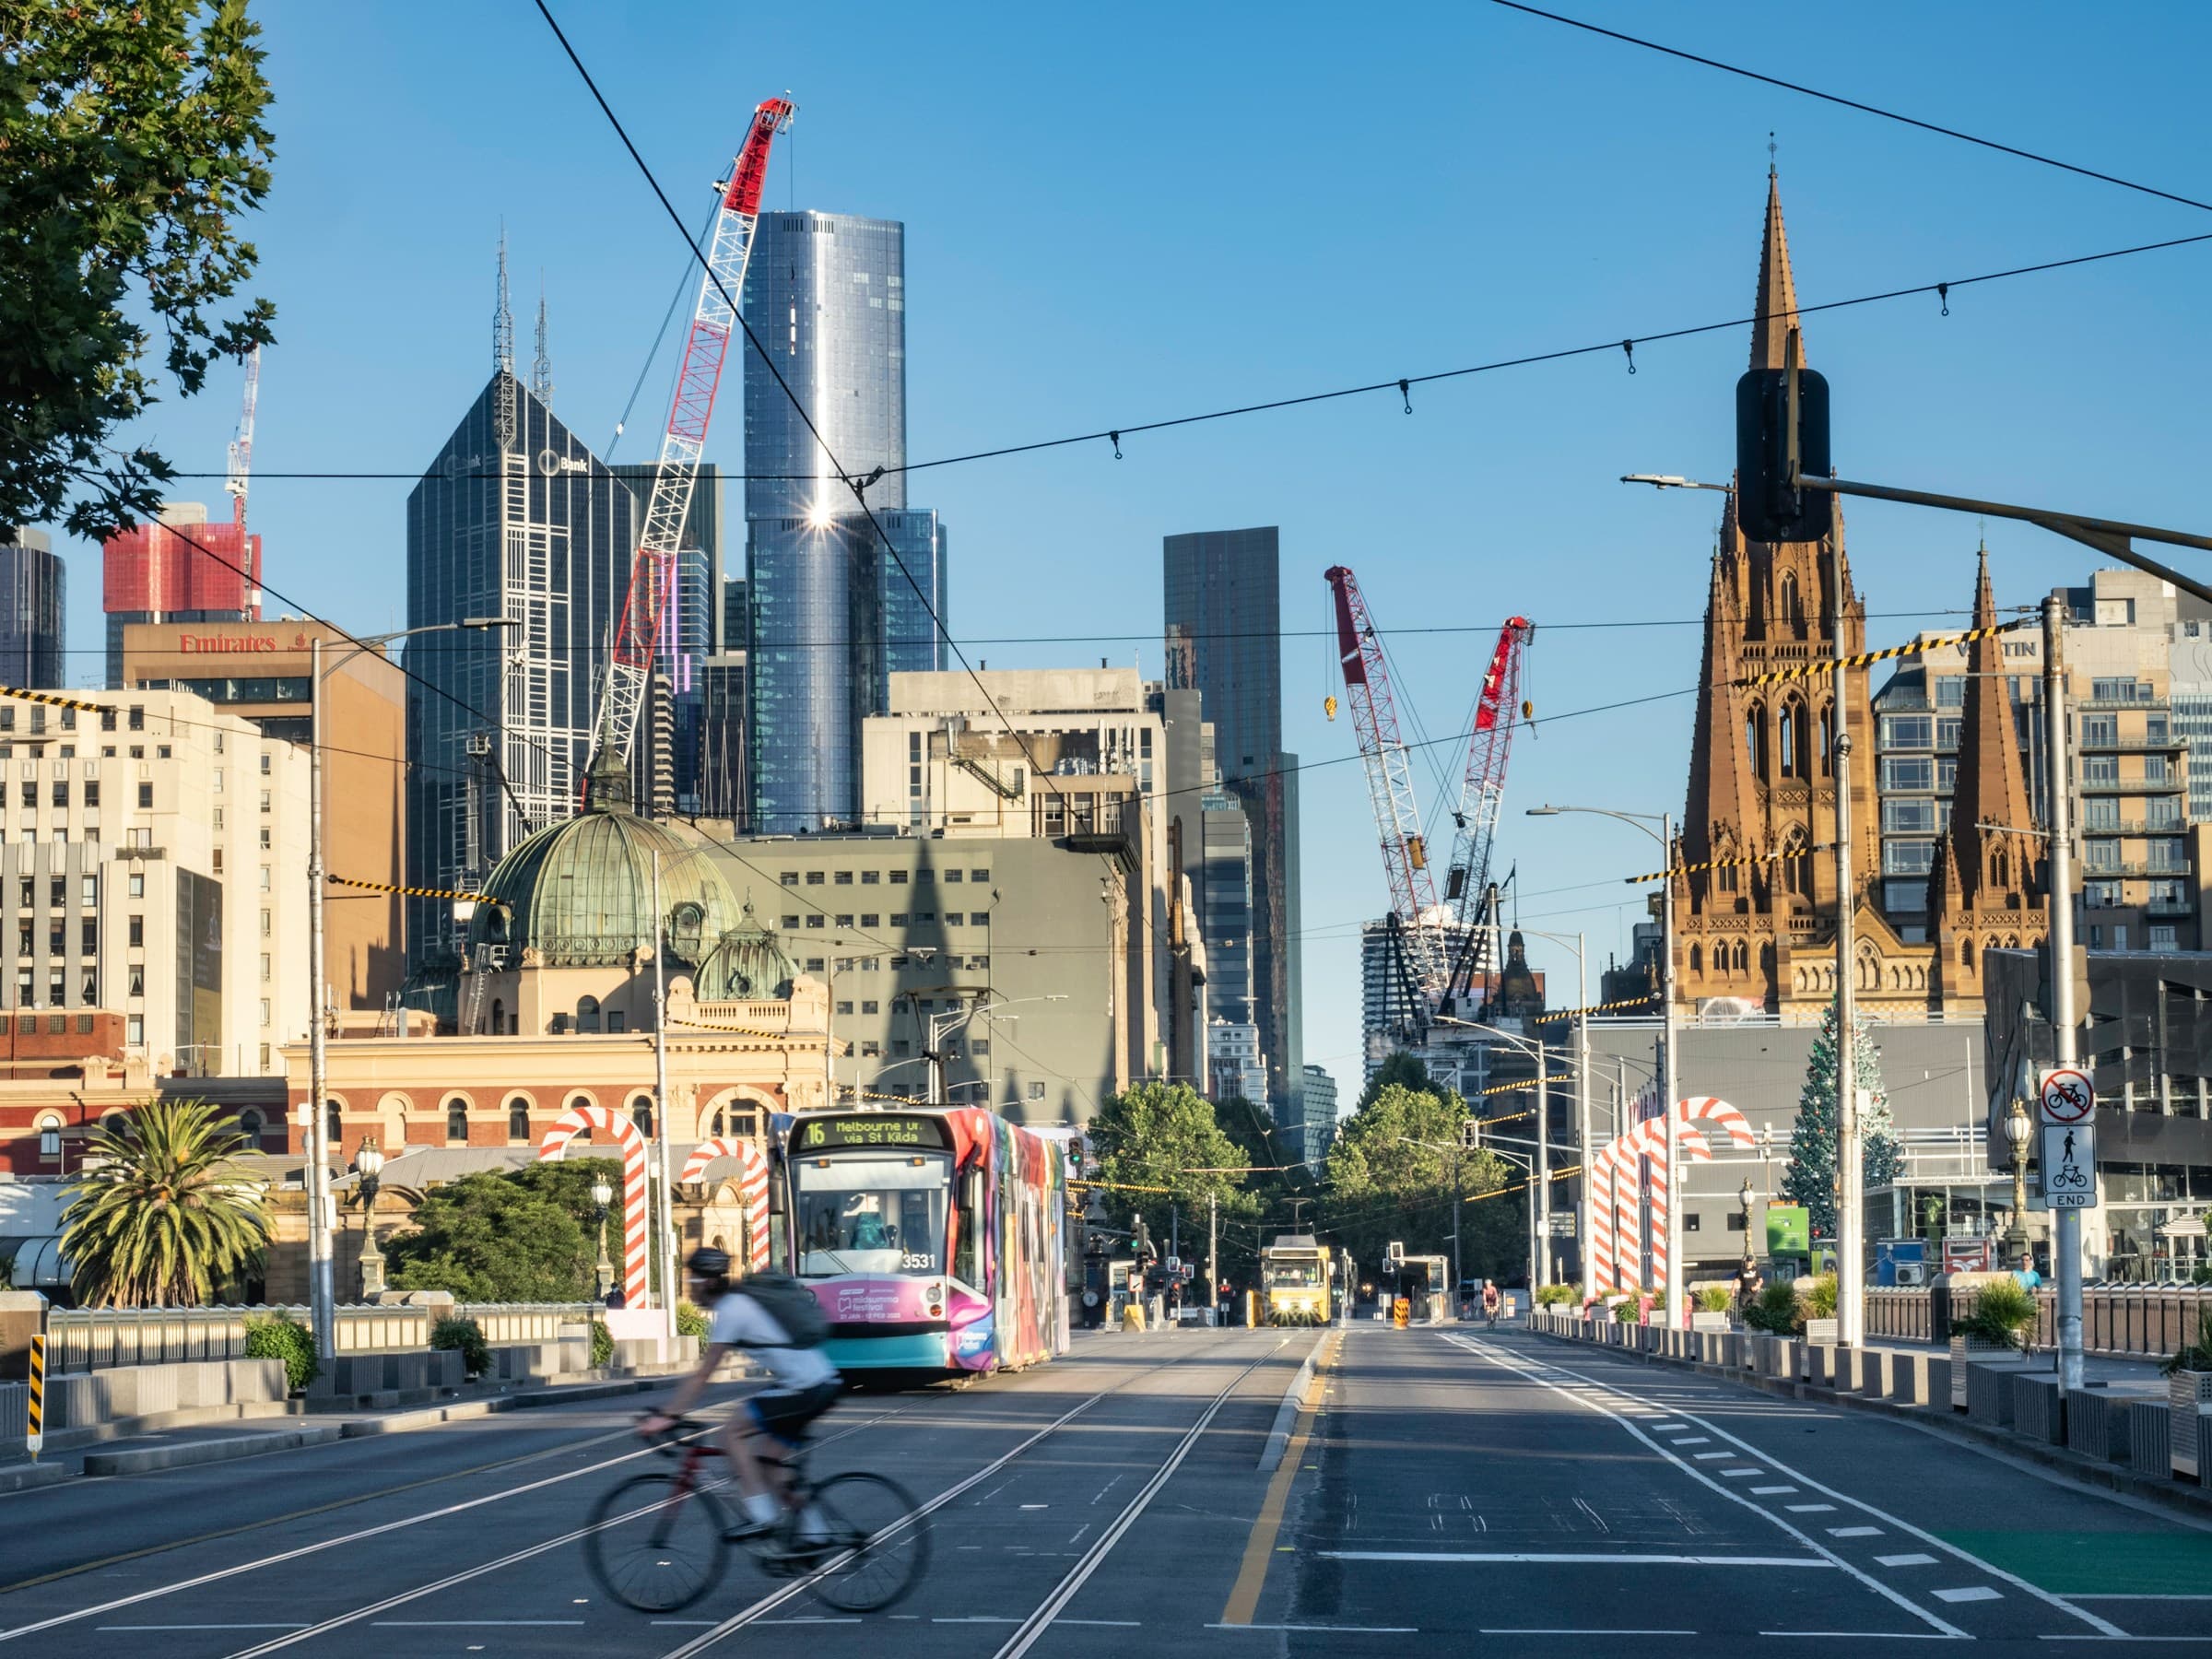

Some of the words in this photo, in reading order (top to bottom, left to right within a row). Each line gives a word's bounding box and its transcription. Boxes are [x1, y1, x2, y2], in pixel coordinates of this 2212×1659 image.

[560, 456, 588, 473] Bank
[180, 633, 276, 653] Emirates
[806, 1123, 825, 1145] 16
[836, 1122, 900, 1133] Melbourne
[844, 1133, 864, 1143] via
[868, 1133, 882, 1143] St
[888, 1132, 918, 1143] Kilda
[2057, 1195, 2086, 1206] END
[902, 1253, 935, 1269] 3531
